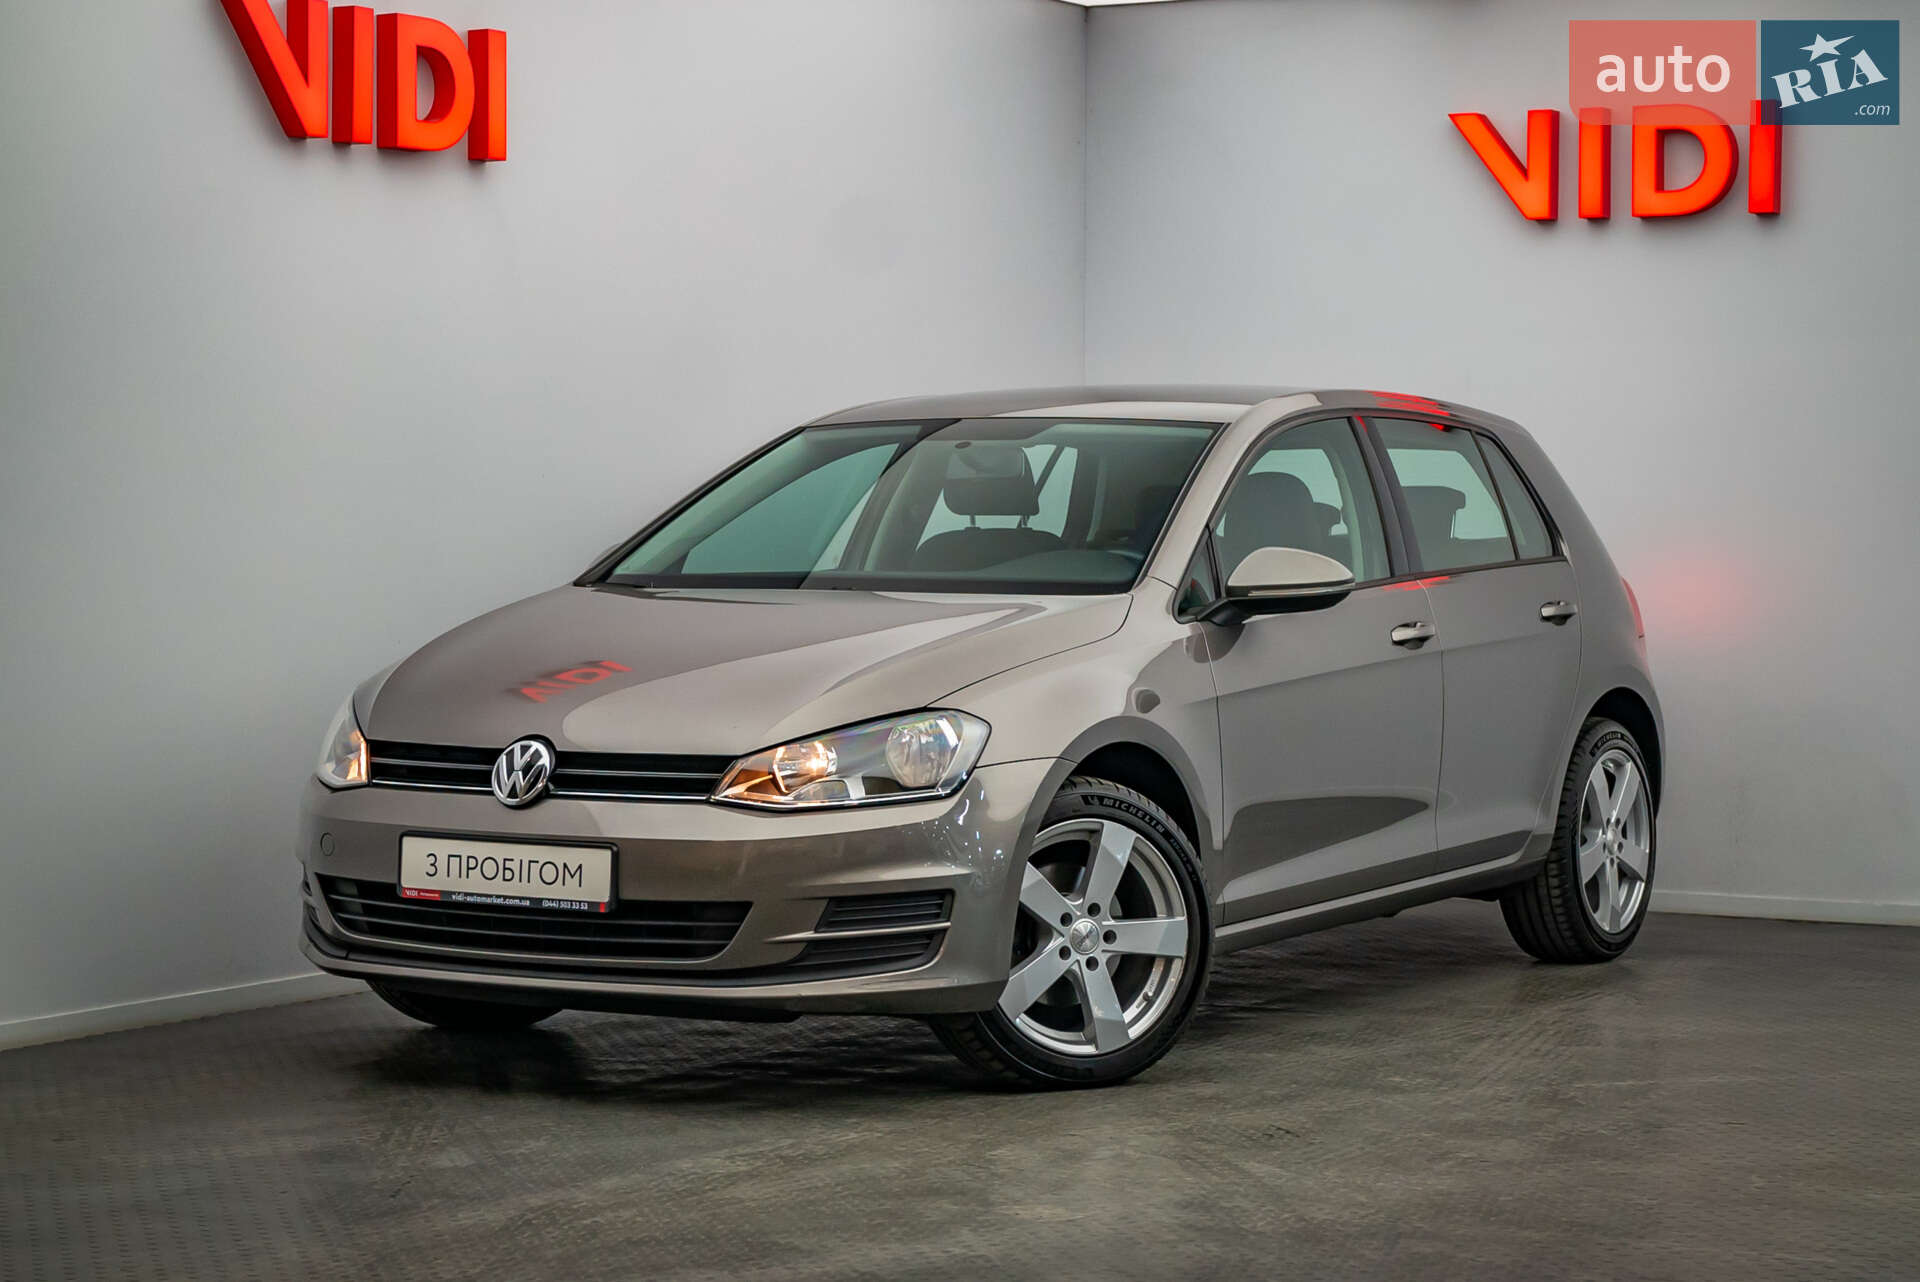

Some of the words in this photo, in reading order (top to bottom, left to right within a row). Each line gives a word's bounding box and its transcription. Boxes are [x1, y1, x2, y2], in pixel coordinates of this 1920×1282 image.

[219, 0, 507, 162] VIDI
[1448, 99, 1783, 221] VIDI
[1102, 798, 1165, 833] MICHELIN
[446, 854, 583, 888] ПРОБІГОМ
[405, 889, 418, 897] VIDI
[451, 893, 530, 906] vidi-automarket.com.ua
[542, 900, 559, 909] (044)
